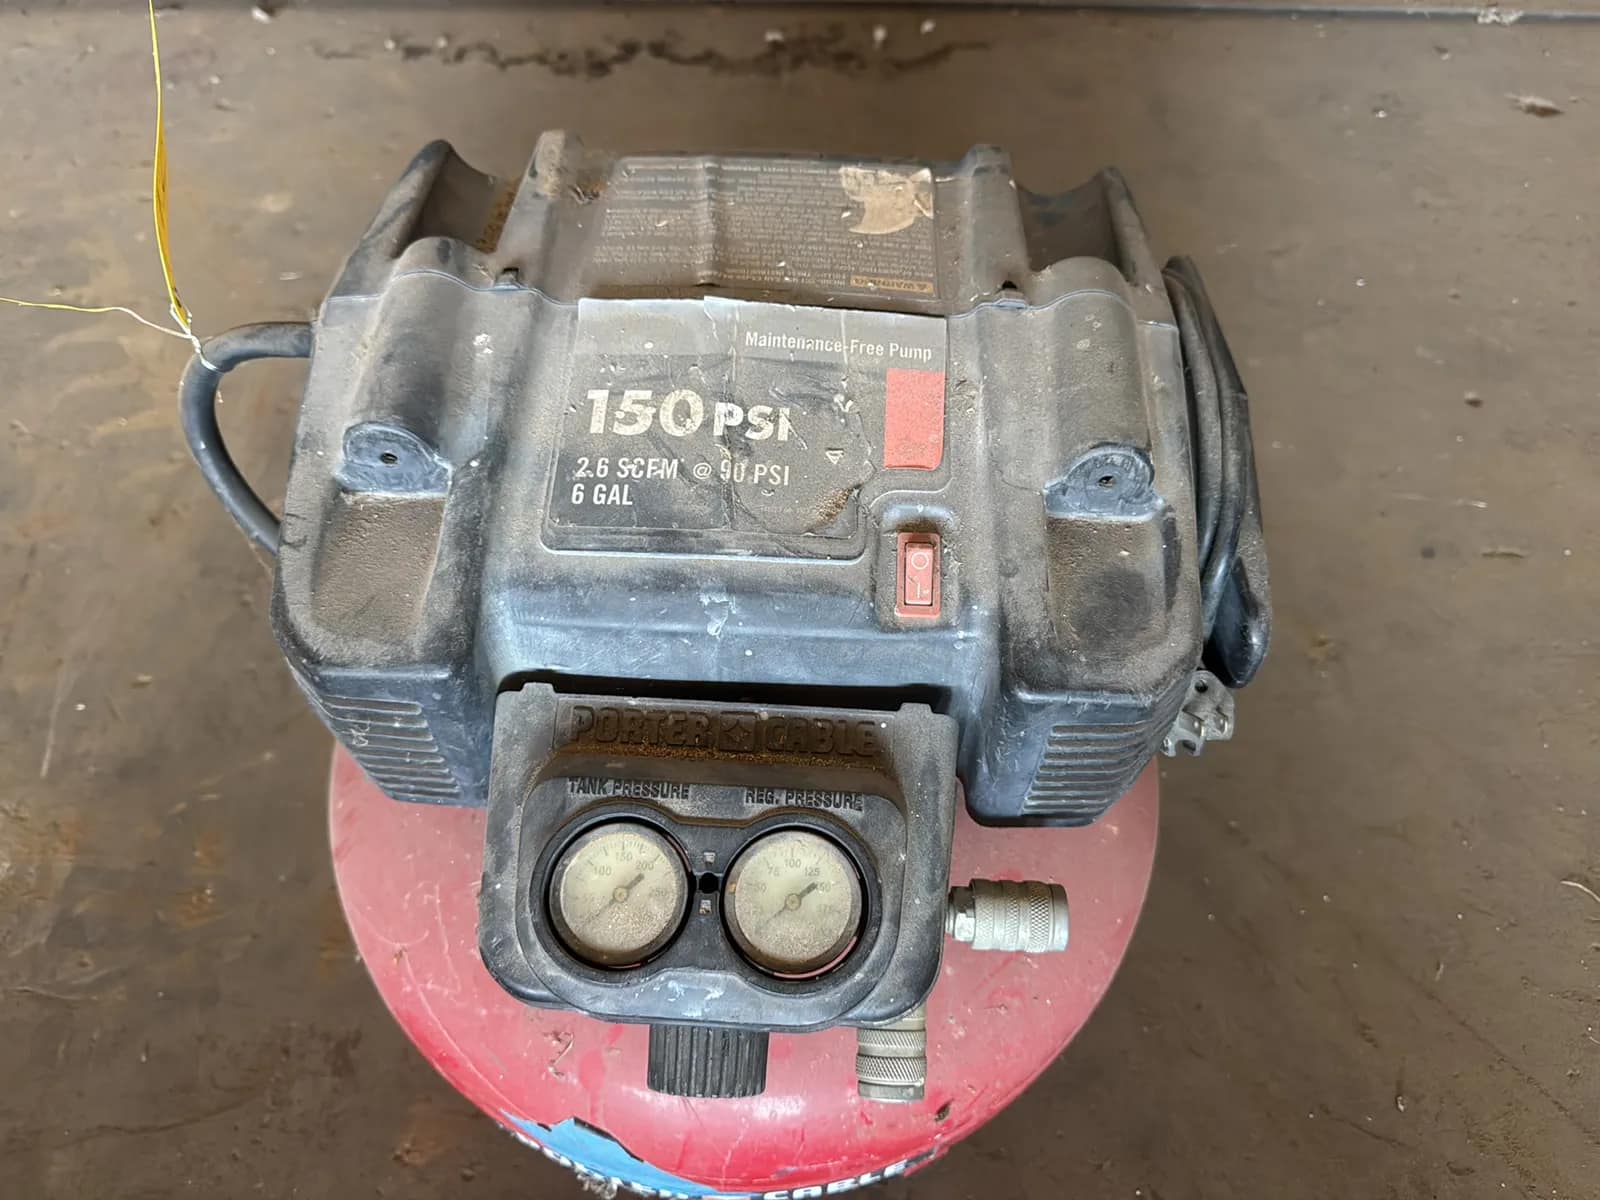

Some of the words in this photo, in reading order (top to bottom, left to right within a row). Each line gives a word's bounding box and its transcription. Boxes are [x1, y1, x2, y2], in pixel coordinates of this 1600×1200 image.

[745, 331, 884, 357] Maintenance-Free
[889, 343, 932, 361] Pump
[586, 389, 704, 437] 150
[712, 402, 790, 441] PSI
[574, 457, 609, 479] 2.6
[616, 457, 678, 480] SCFM
[693, 462, 712, 480] @
[720, 463, 746, 484] 90
[753, 464, 790, 487] PSI
[571, 483, 584, 506] 6
[593, 484, 634, 506] GAL
[569, 705, 711, 750] PORTER
[765, 716, 876, 757] CABLE
[568, 777, 608, 795] TANK
[613, 782, 690, 800] PRESSURE
[745, 790, 781, 806] REG.
[785, 792, 864, 812] PRESSURE
[615, 852, 633, 862] 150
[784, 858, 802, 868] 100
[593, 864, 612, 876] 100
[804, 866, 821, 877] 125
